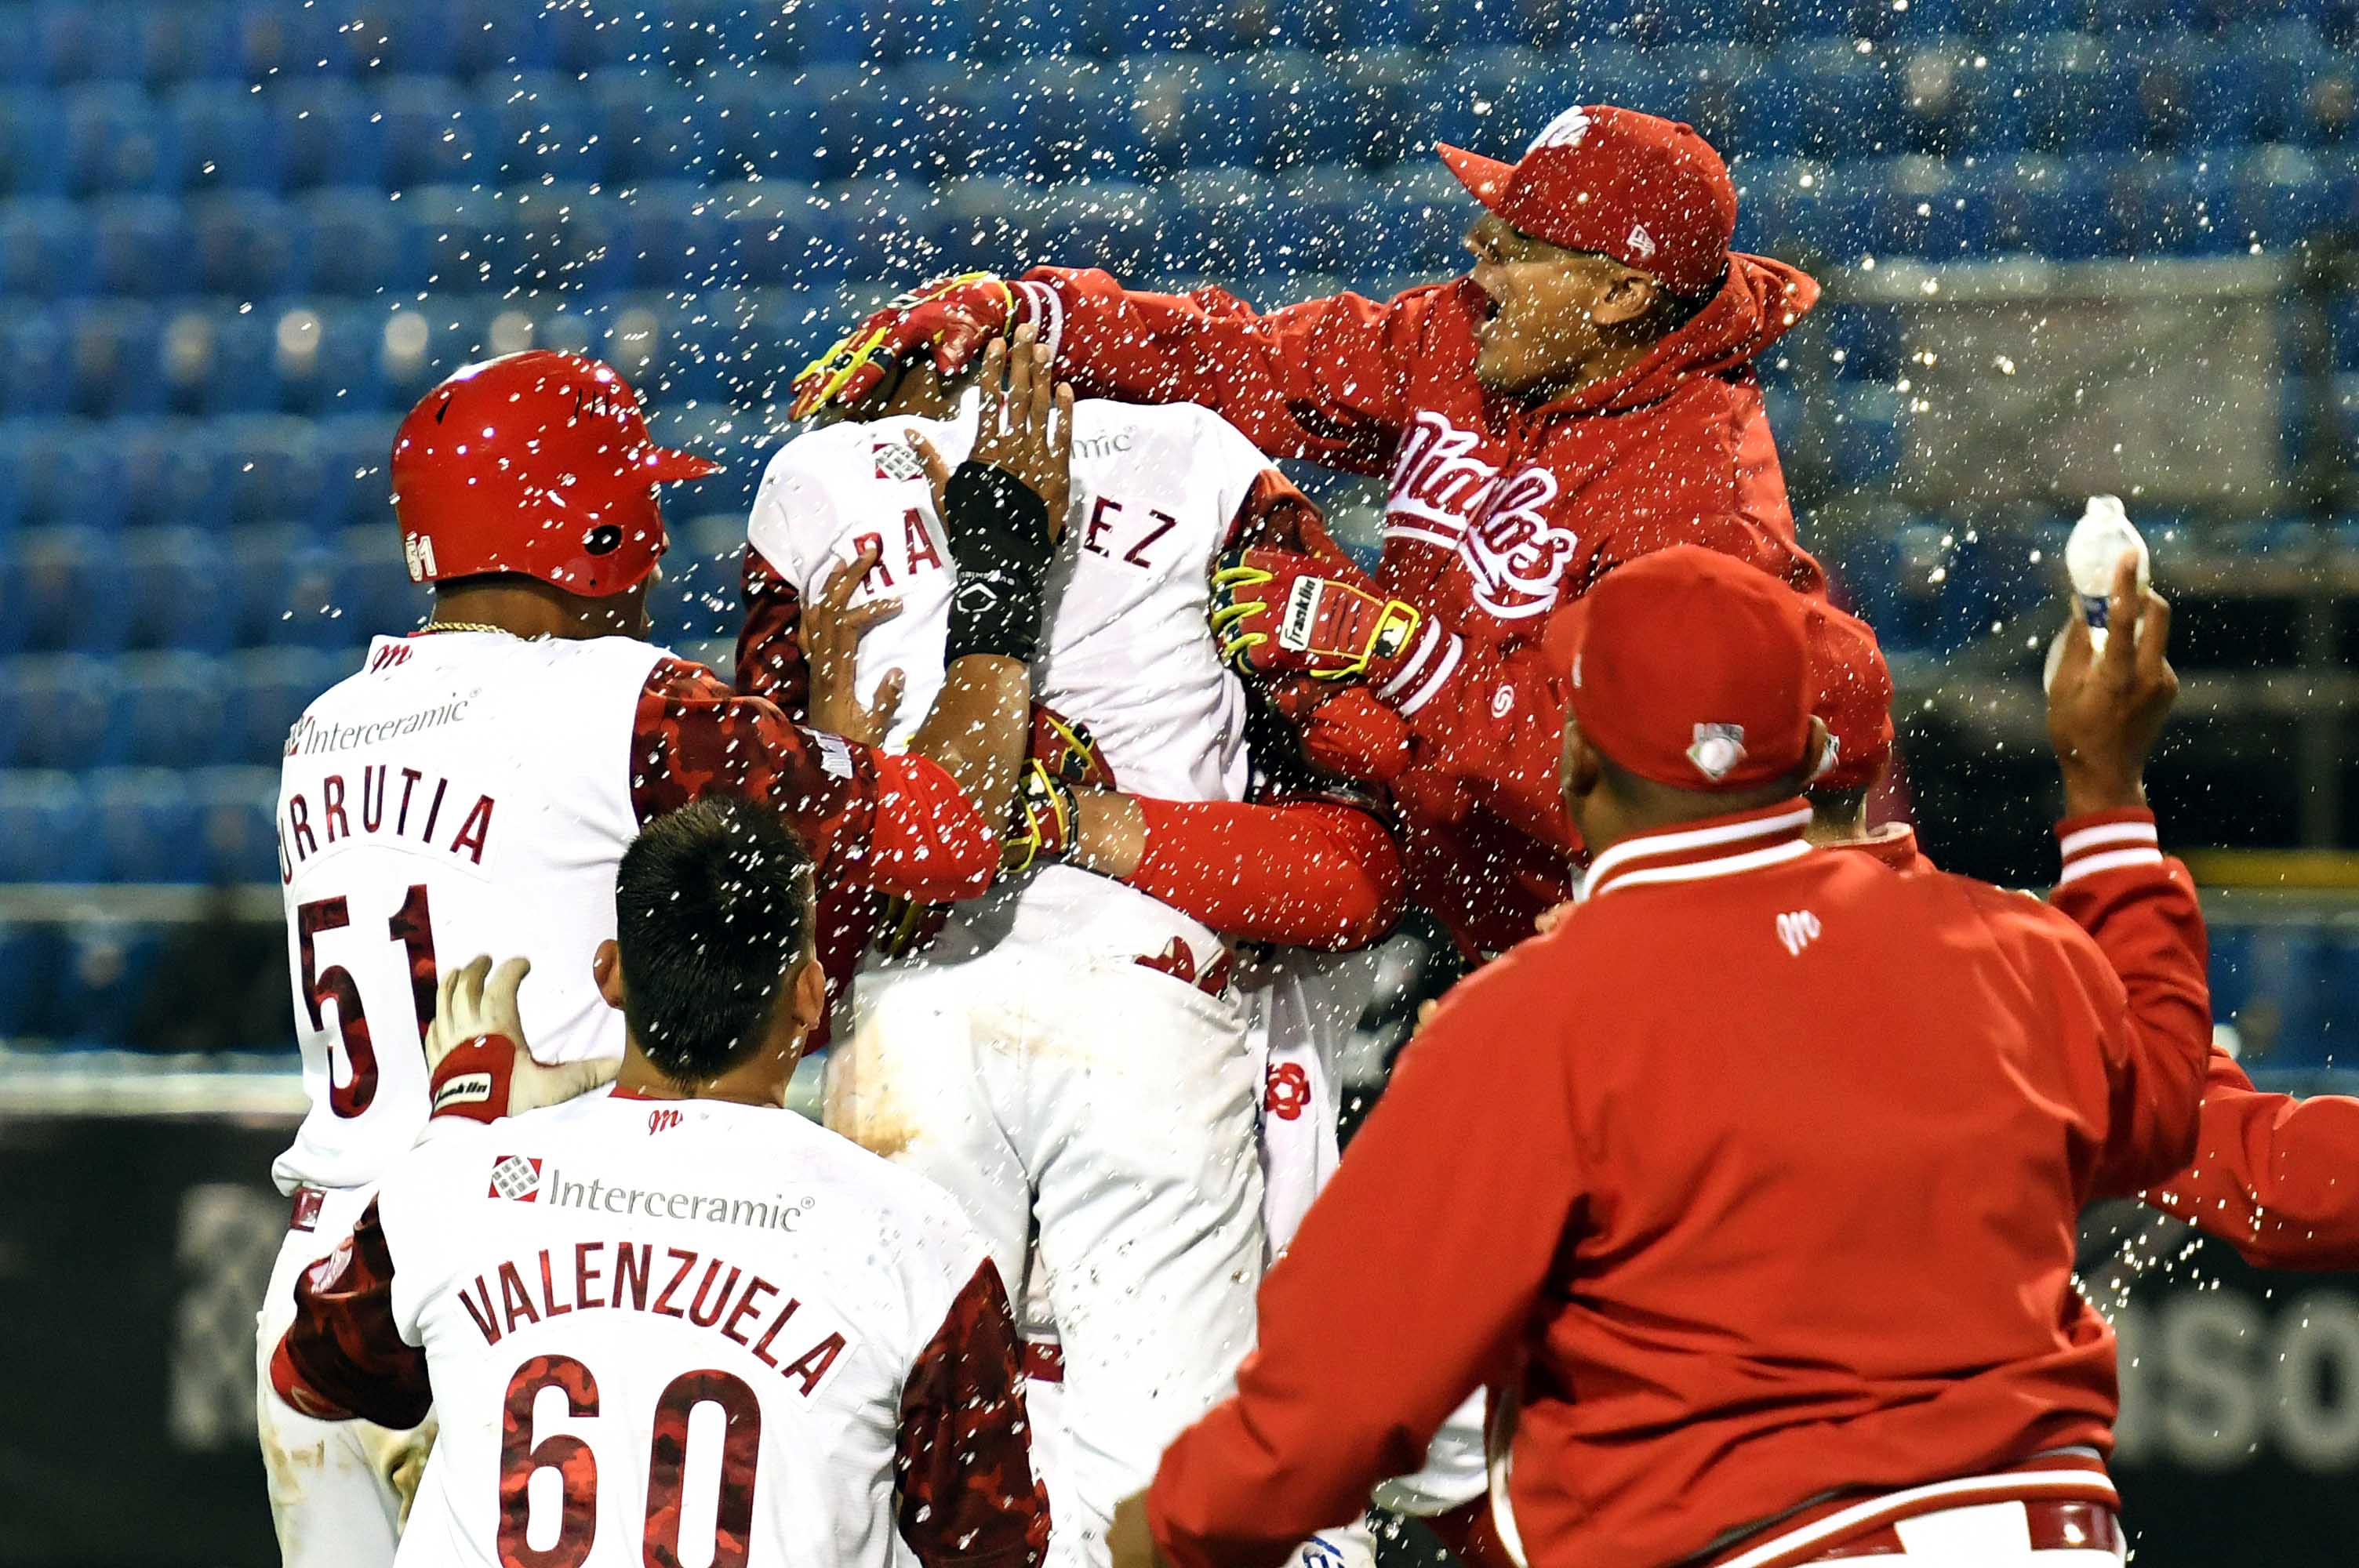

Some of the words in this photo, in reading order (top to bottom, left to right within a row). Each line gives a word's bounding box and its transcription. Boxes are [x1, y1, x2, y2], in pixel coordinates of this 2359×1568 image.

[405, 535, 438, 582] 51
[1284, 577, 1317, 647] Franklin
[277, 764, 496, 885] URRUTIA
[298, 884, 438, 1120] 51
[458, 1241, 848, 1397] VALENZUELA
[496, 1353, 761, 1568] 60
